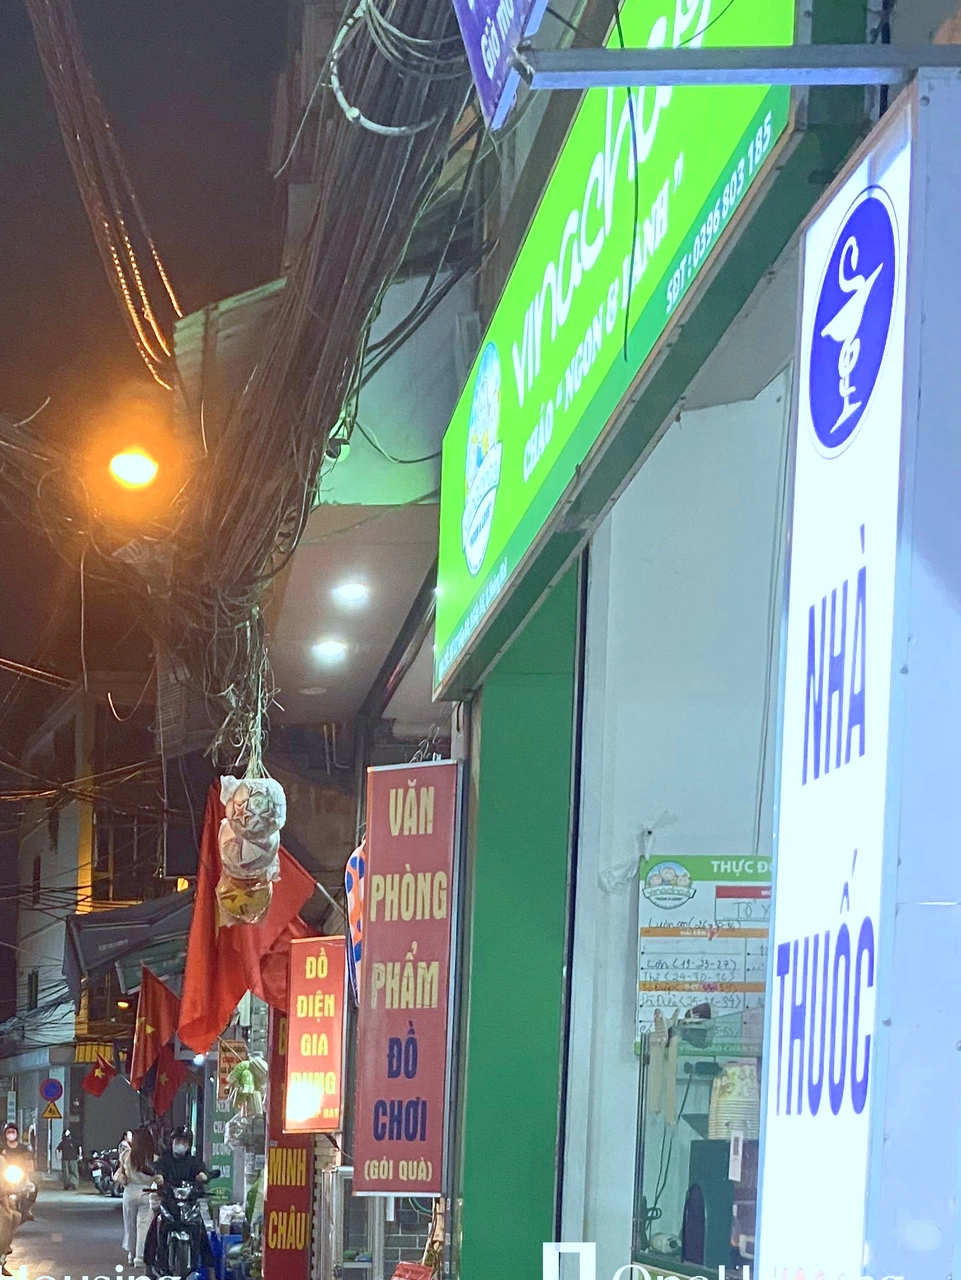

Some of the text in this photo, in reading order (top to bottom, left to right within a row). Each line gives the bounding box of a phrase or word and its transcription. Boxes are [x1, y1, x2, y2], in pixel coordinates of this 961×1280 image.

[747, 110, 772, 176] 185
[802, 524, 867, 786] NHÀ
[389, 778, 434, 836] VĂN
[711, 859, 754, 877] THỰC
[370, 863, 447, 922] PHÒNG
[305, 947, 328, 979] ĐỒ
[371, 940, 439, 1009] PHẨM
[776, 849, 874, 1116] THUỐC
[296, 990, 335, 1022] ĐIỆN
[300, 1033, 328, 1056] GIA
[387, 1020, 418, 1079] ĐỒ
[373, 1096, 427, 1141] CHƠI
[269, 1148, 306, 1186] MINH
[364, 1156, 432, 1181] (GÓI QUÀ)
[268, 1205, 306, 1250] CHÂU
